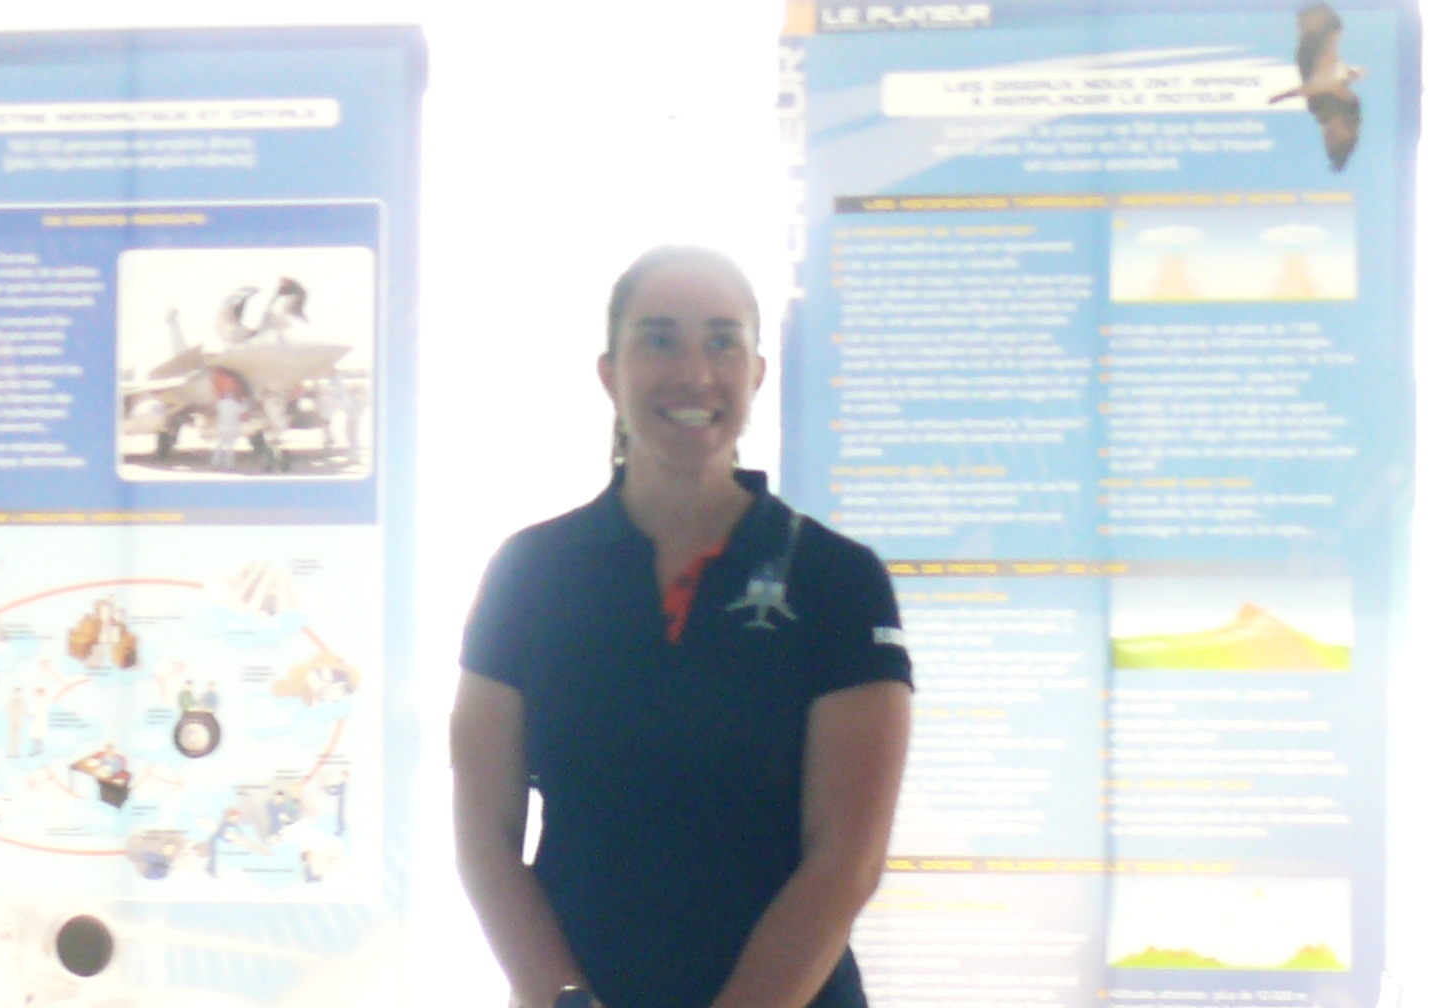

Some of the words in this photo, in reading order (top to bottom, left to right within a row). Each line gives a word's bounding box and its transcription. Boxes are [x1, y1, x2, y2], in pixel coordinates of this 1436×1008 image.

[822, 7, 859, 25] LE
[867, 4, 991, 24] PLANEUR
[943, 80, 982, 92] LES
[991, 79, 1070, 91] OISEAUX
[1084, 78, 1132, 90] NOUS
[1143, 77, 1179, 89] ONT
[992, 95, 1109, 107] REMPLACER
[1118, 94, 1143, 105] LE
[1155, 92, 1234, 104] MOTEUR
[197, 109, 220, 121] ET
[229, 107, 316, 120] SPATIALE
